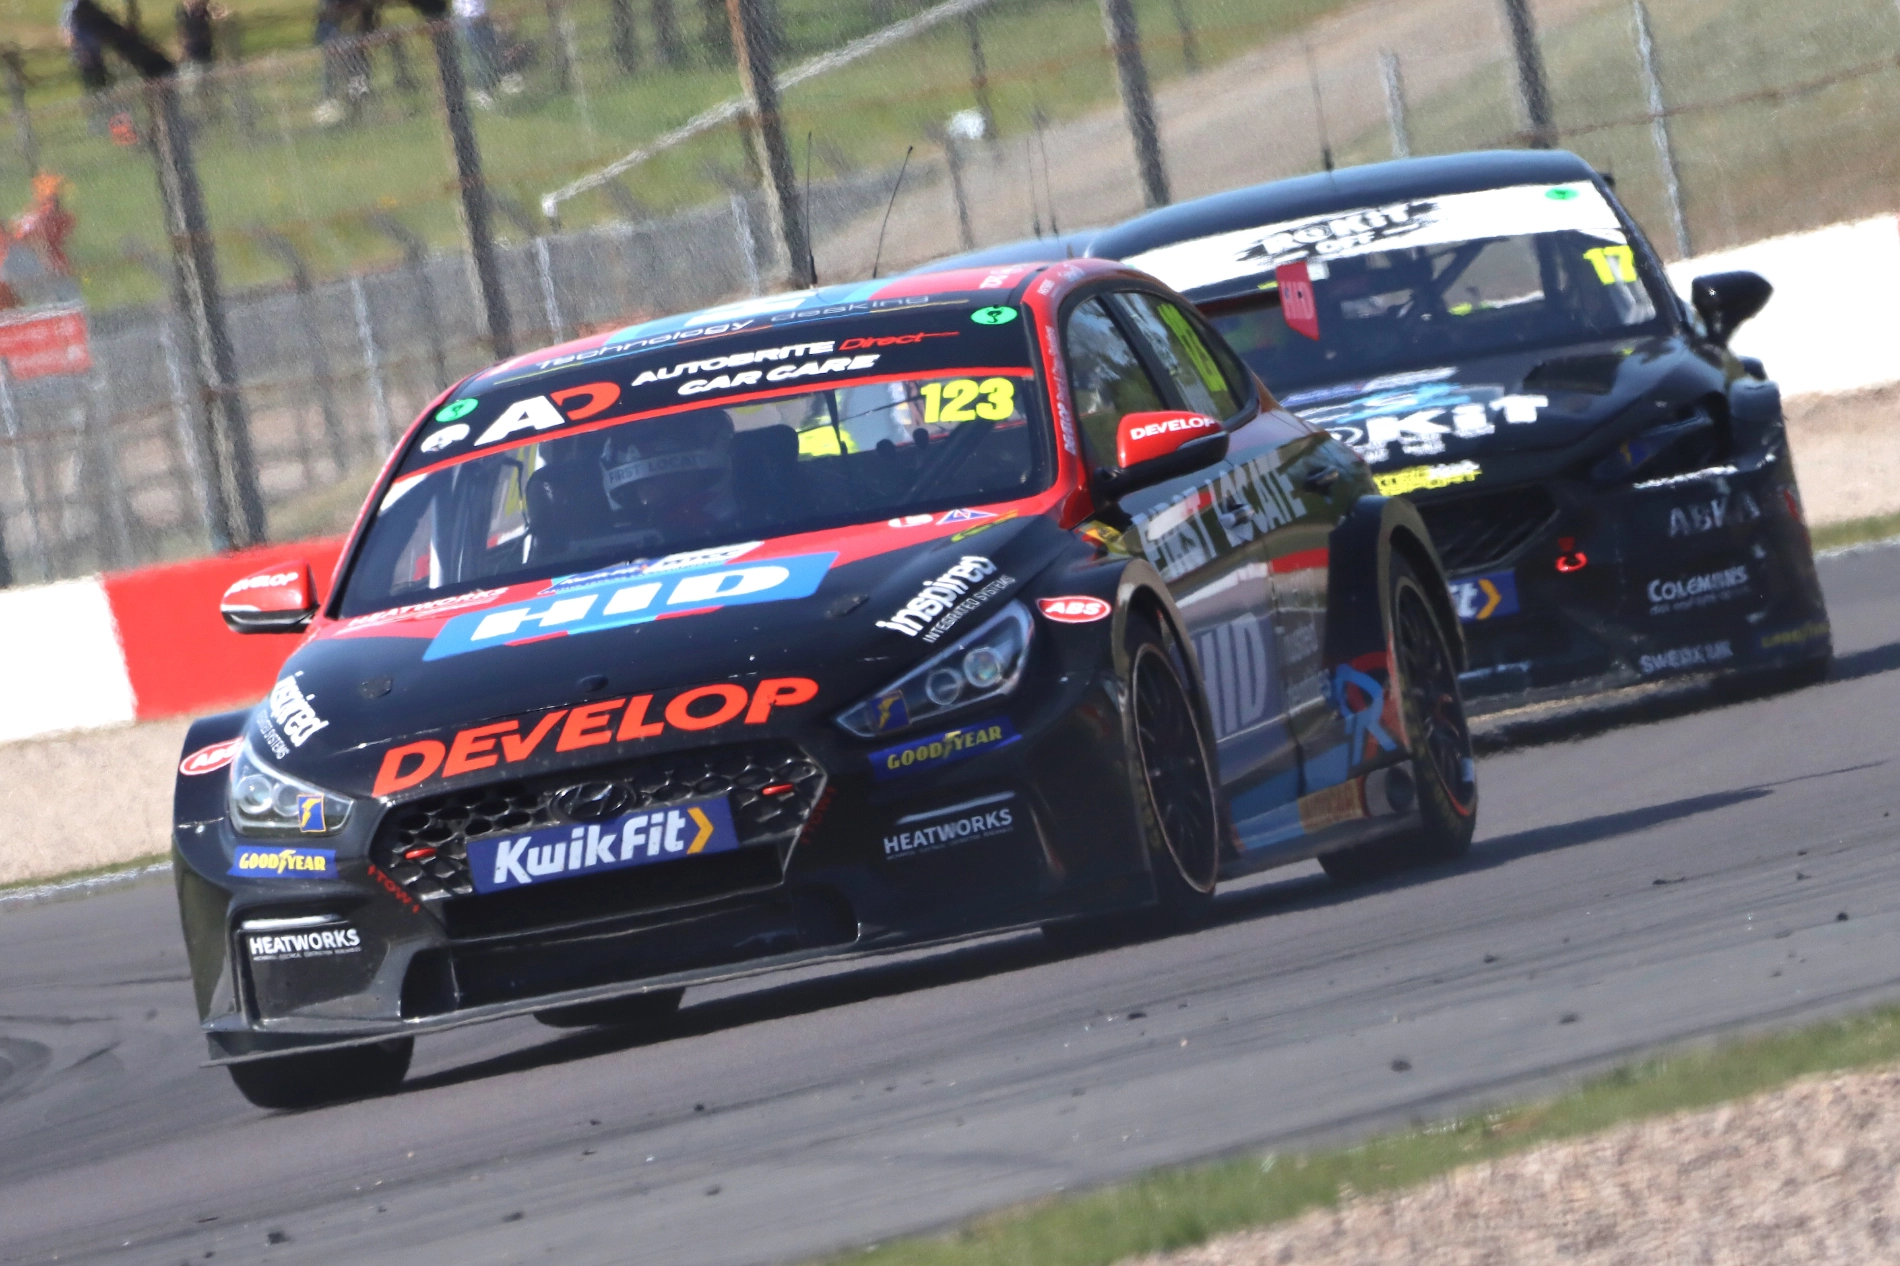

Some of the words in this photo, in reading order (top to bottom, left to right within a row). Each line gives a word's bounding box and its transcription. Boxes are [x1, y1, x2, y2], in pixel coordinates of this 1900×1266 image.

[1583, 244, 1637, 285] 17
[630, 340, 835, 387] AUTOBRITE
[838, 332, 950, 352] Direct
[677, 364, 765, 397] CAR
[764, 353, 882, 384] CARE
[920, 377, 1014, 423] 123
[1130, 417, 1216, 441] DEVELOP
[470, 565, 790, 641] HID
[876, 555, 997, 637] inspired
[1045, 600, 1103, 616] ABS
[372, 677, 819, 798] DEVELOP
[886, 725, 1003, 769] GOODYEAR
[883, 807, 1013, 855] HEATWORKS
[239, 849, 326, 875] GOODYEAR
[250, 928, 361, 956] HEATWORKS
